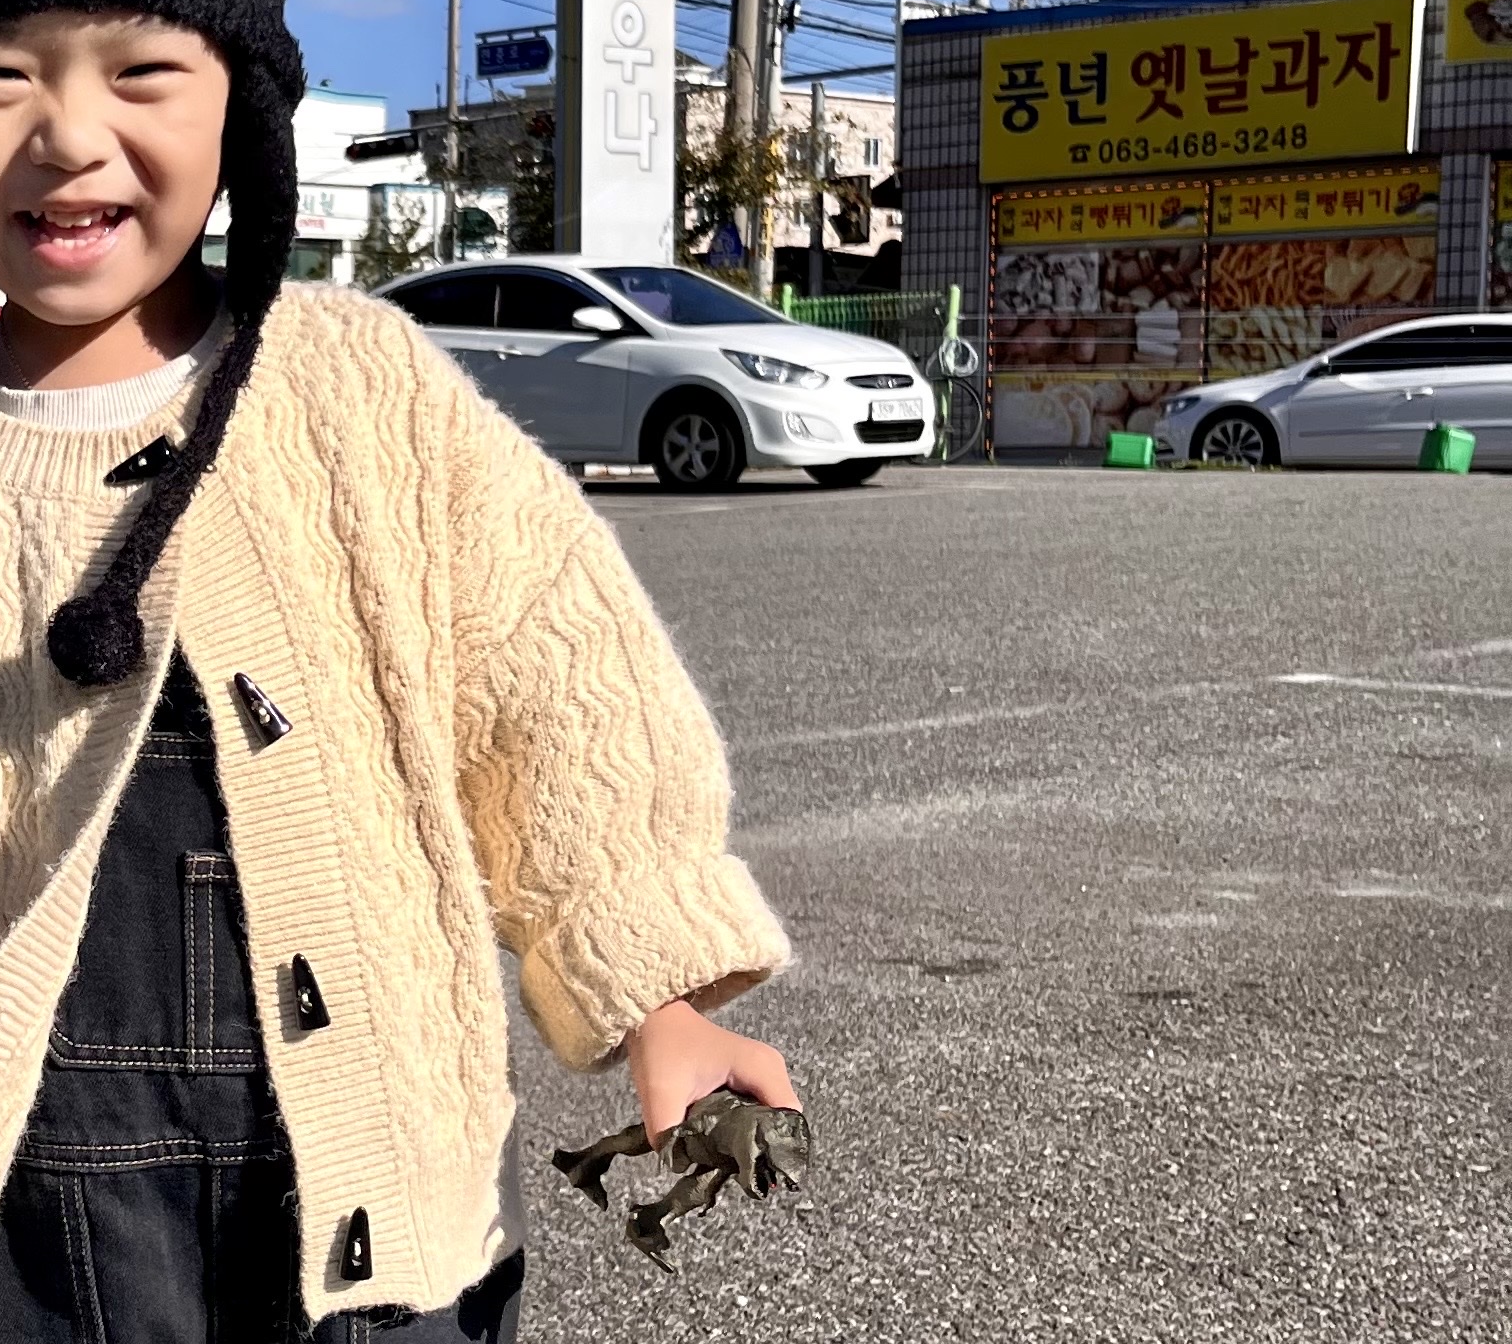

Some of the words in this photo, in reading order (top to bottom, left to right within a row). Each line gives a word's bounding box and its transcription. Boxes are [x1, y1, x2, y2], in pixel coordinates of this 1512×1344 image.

[993, 51, 1109, 134] 풍년
[1130, 21, 1400, 124] 옛날과자
[1098, 123, 1308, 164] 063-468-3248
[1021, 206, 1063, 233] 과자
[1089, 201, 1155, 230] 뻥튀기
[1239, 192, 1287, 222] 과자
[1316, 186, 1391, 218] 뻥튀기
